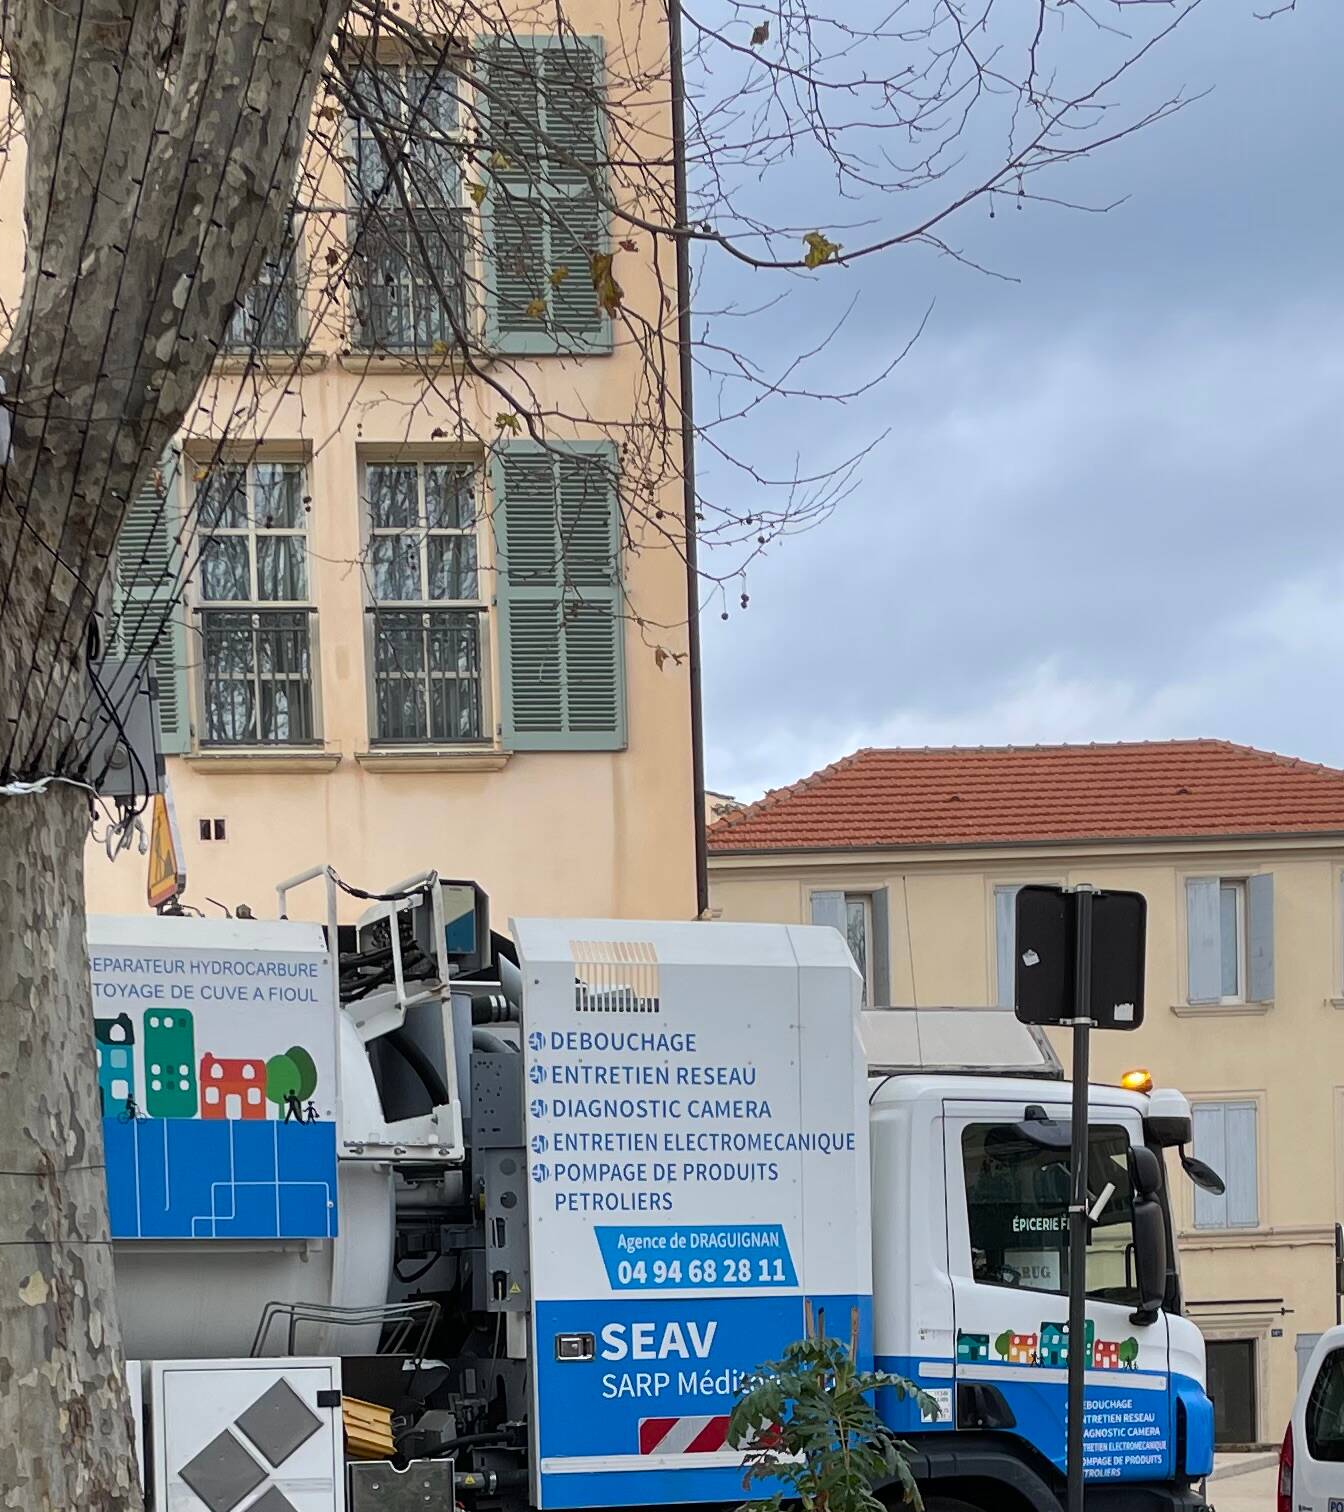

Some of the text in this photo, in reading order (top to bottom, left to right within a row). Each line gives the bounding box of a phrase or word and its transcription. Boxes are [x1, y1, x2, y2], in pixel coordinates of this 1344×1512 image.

[190, 960, 318, 977] HYDROCARBURE
[93, 982, 319, 1002] TOYAGE DE CUVE A FIOUL
[550, 1032, 697, 1052] DEBOUCHAGE
[551, 1066, 757, 1085] ENTRETIEN RESEAU
[552, 1099, 772, 1119] DIAGNOSTIC CAMERA
[553, 1132, 856, 1154] ENTRETIEN ELECTROMECANIQUE
[554, 1162, 779, 1182] POMPAGE DE PRODUITS
[555, 1192, 673, 1211] PETROLIERS
[1012, 1215, 1060, 1233] ÉPICERIE
[617, 1231, 780, 1254] Agence de DRAGUIGNAN
[617, 1258, 786, 1284] 04 94 68 28 11
[600, 1321, 718, 1361] SEAV
[602, 1372, 670, 1399] SARP
[1123, 1412, 1156, 1423] RESEAU
[1083, 1426, 1161, 1438] AGNOSTIC CAMERA
[1113, 1455, 1124, 1466] DE
[1124, 1454, 1163, 1465] PRODUITS
[1083, 1467, 1121, 1478] TROLIERS
